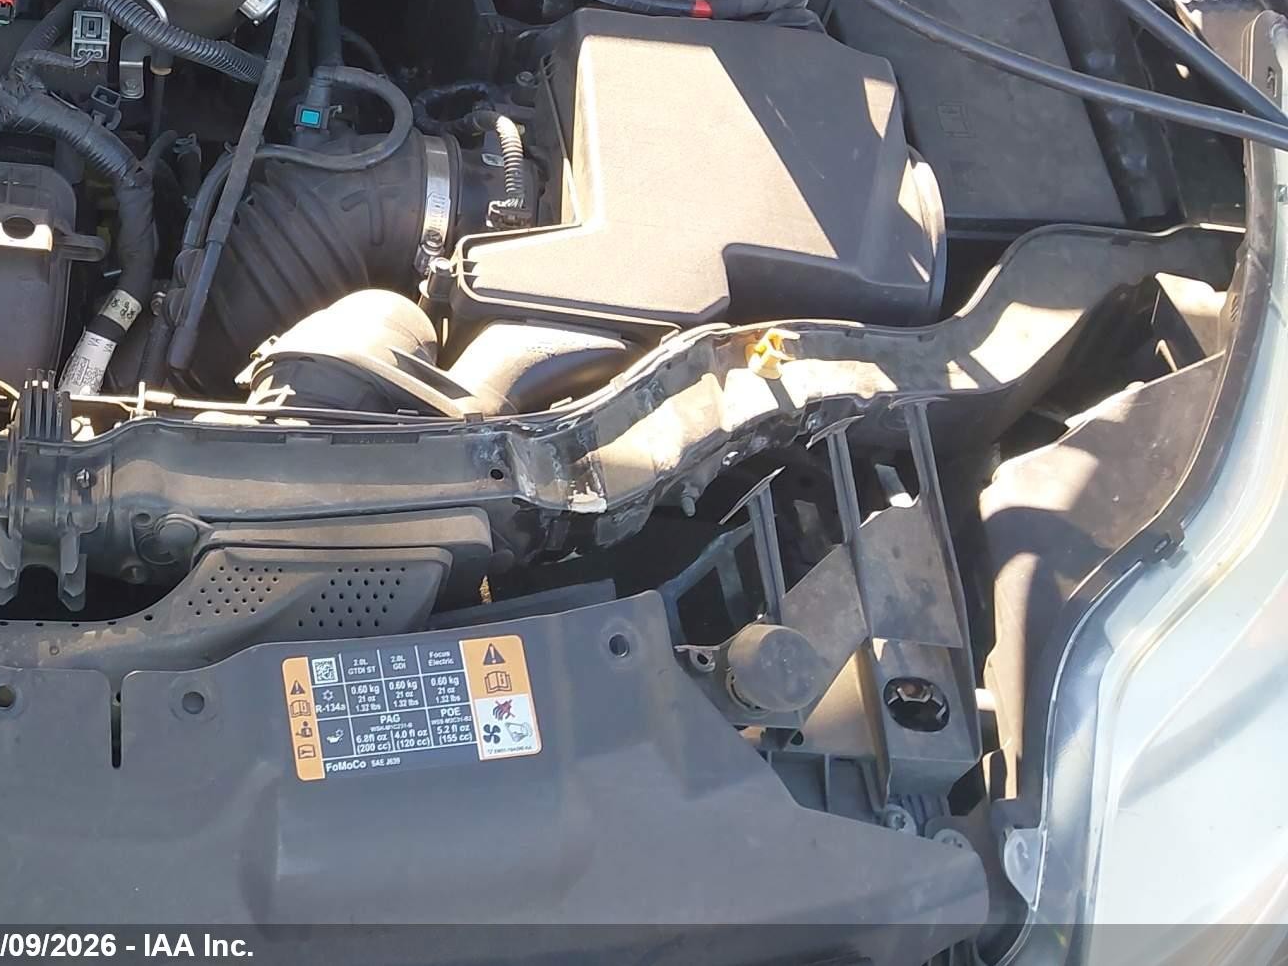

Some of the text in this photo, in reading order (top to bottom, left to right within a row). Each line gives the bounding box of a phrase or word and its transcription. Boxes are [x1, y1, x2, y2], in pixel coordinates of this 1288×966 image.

[428, 658, 454, 667] Electric
[389, 680, 418, 691] 0.60 kg
[431, 676, 459, 686] 0.60 kg
[351, 684, 380, 695] 0.60 kg
[316, 703, 346, 713] R-134a
[441, 707, 461, 717] POE
[380, 714, 400, 724] PAG
[395, 731, 407, 739] 4.0
[410, 730, 416, 738] fl
[437, 726, 450, 734] 5.2
[452, 725, 457, 733] fl
[396, 737, 430, 750] (120 cc)
[439, 733, 473, 745] (155 cc)
[357, 742, 391, 754] (200 cc)
[325, 760, 367, 772] FoMoCo
[371, 759, 385, 767] SAE
